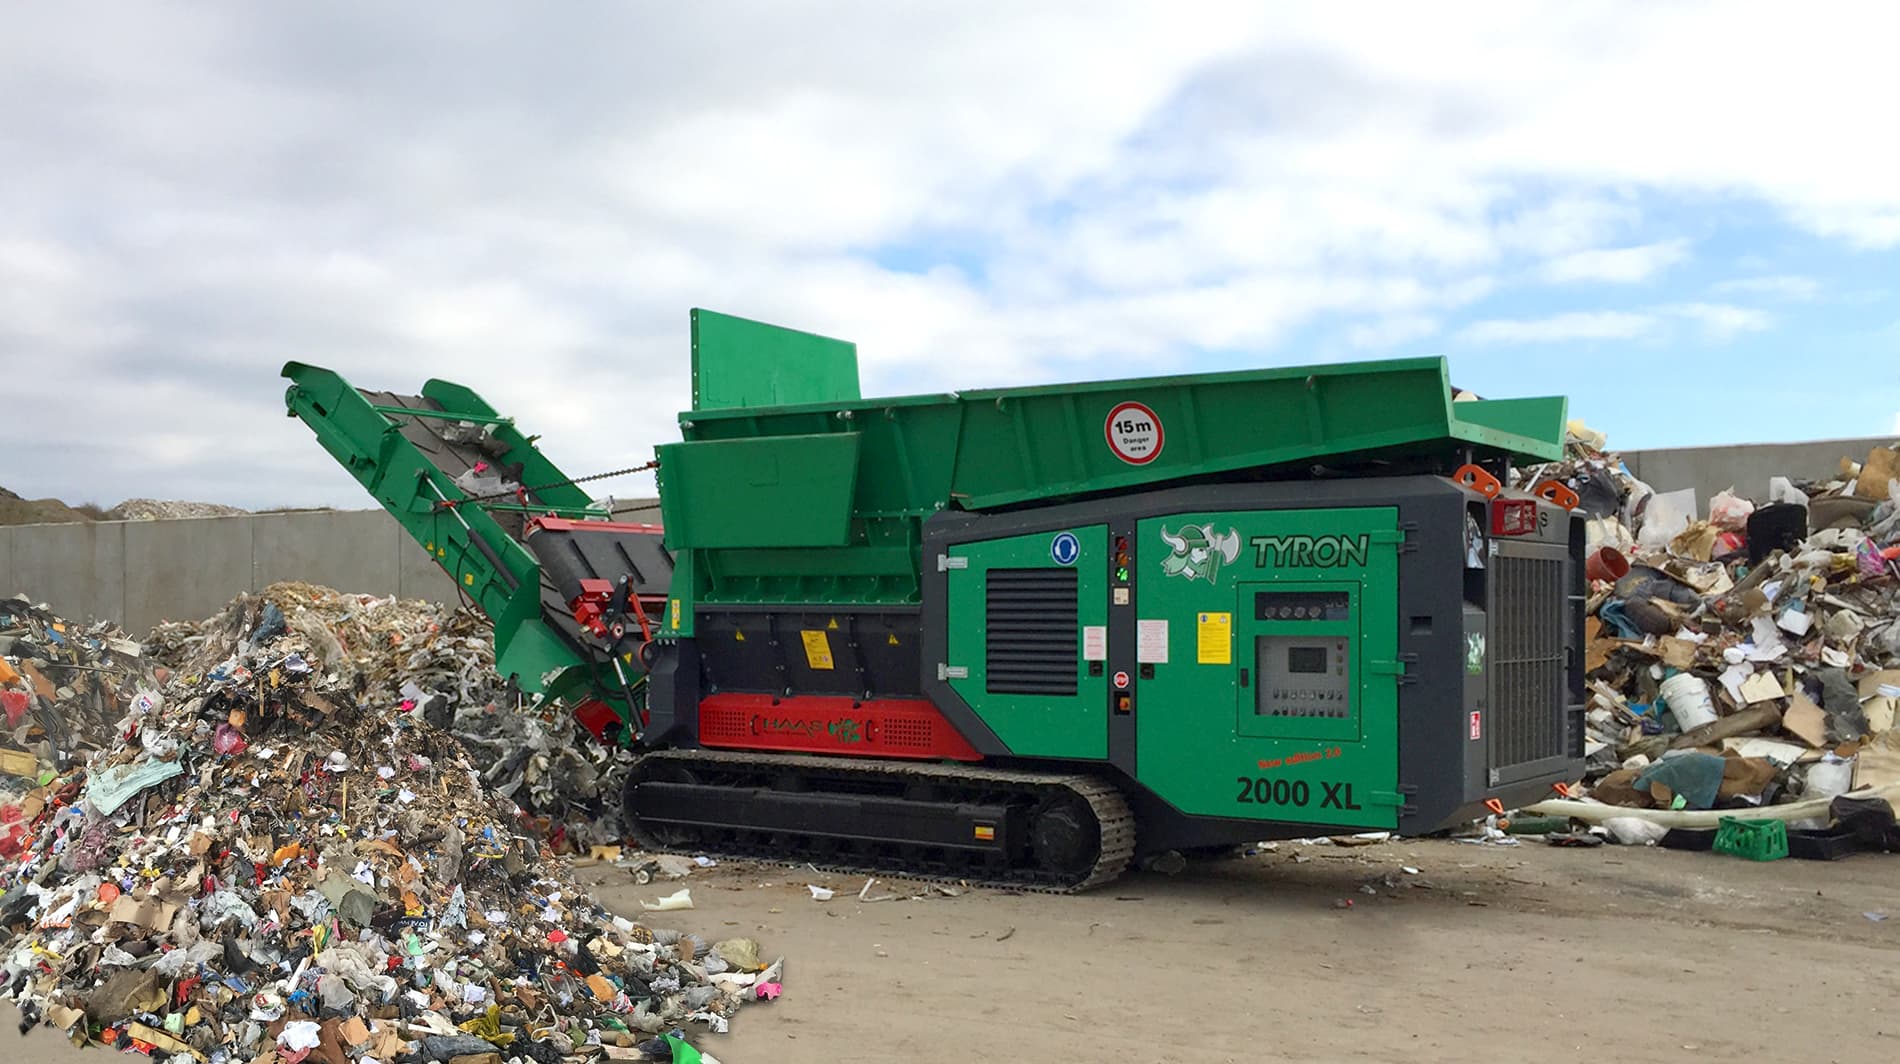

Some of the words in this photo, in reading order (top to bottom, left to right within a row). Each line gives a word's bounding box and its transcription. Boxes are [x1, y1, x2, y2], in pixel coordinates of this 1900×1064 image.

[1250, 534, 1370, 568] TYRON
[763, 718, 823, 736] HAAS
[1237, 777, 1309, 807] 2000
[1320, 781, 1361, 810] XL
